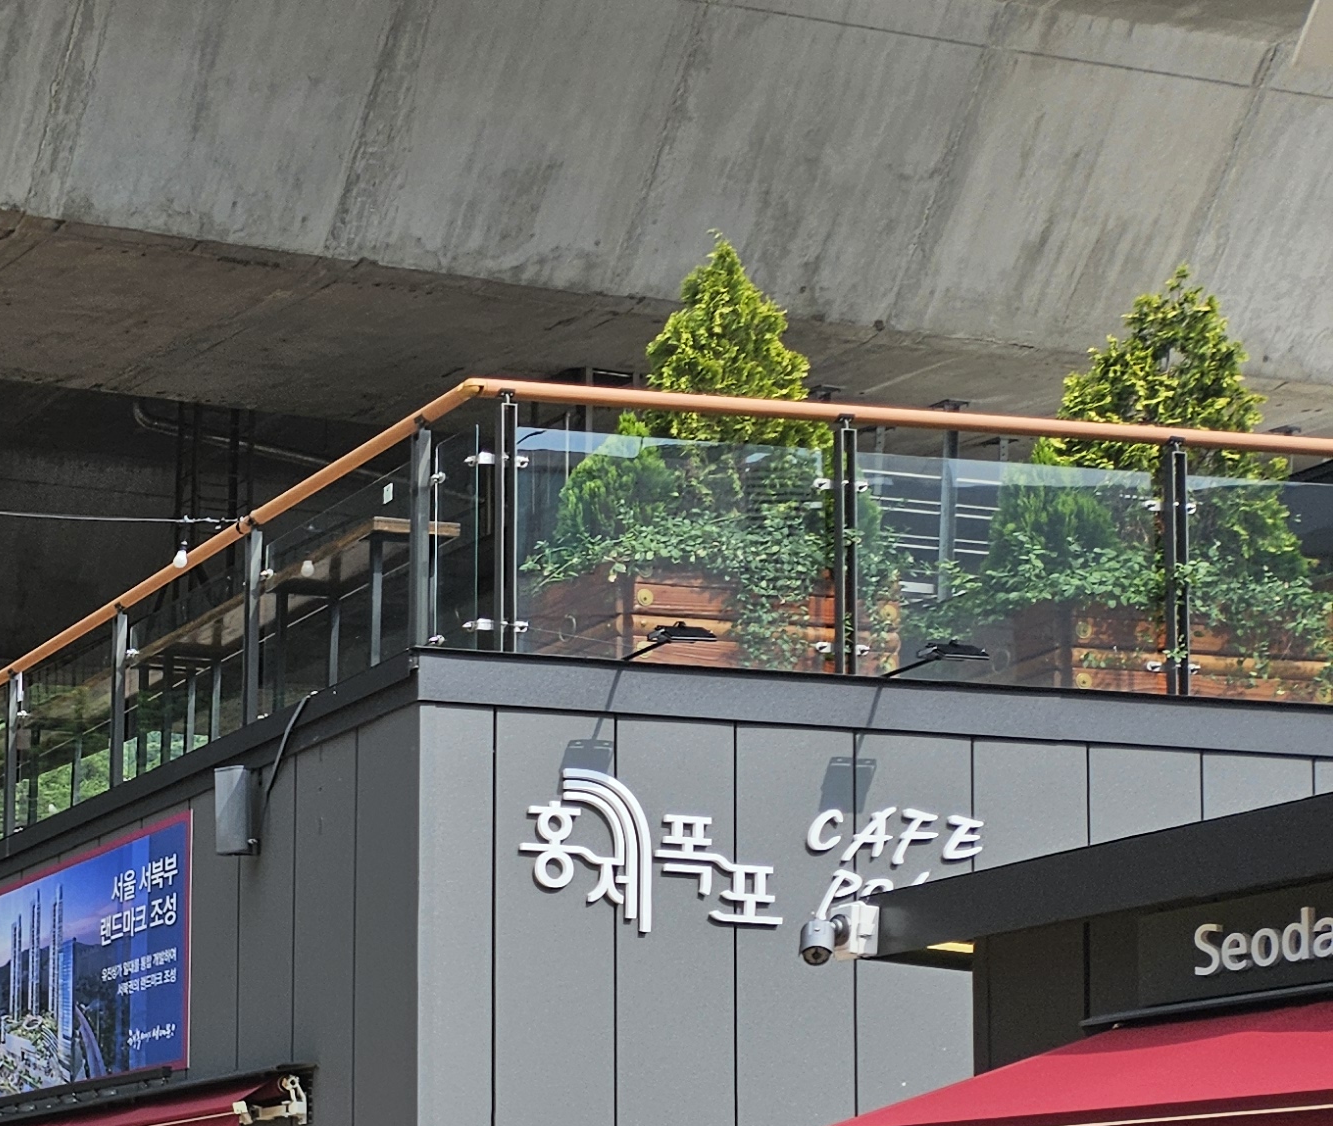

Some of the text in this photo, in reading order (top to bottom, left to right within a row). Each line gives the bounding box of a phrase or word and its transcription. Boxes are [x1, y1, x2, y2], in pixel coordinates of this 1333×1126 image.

[807, 806, 984, 866] CAFE
[111, 853, 178, 903] 서울 서북부
[100, 892, 177, 947] 랜드마크 조성
